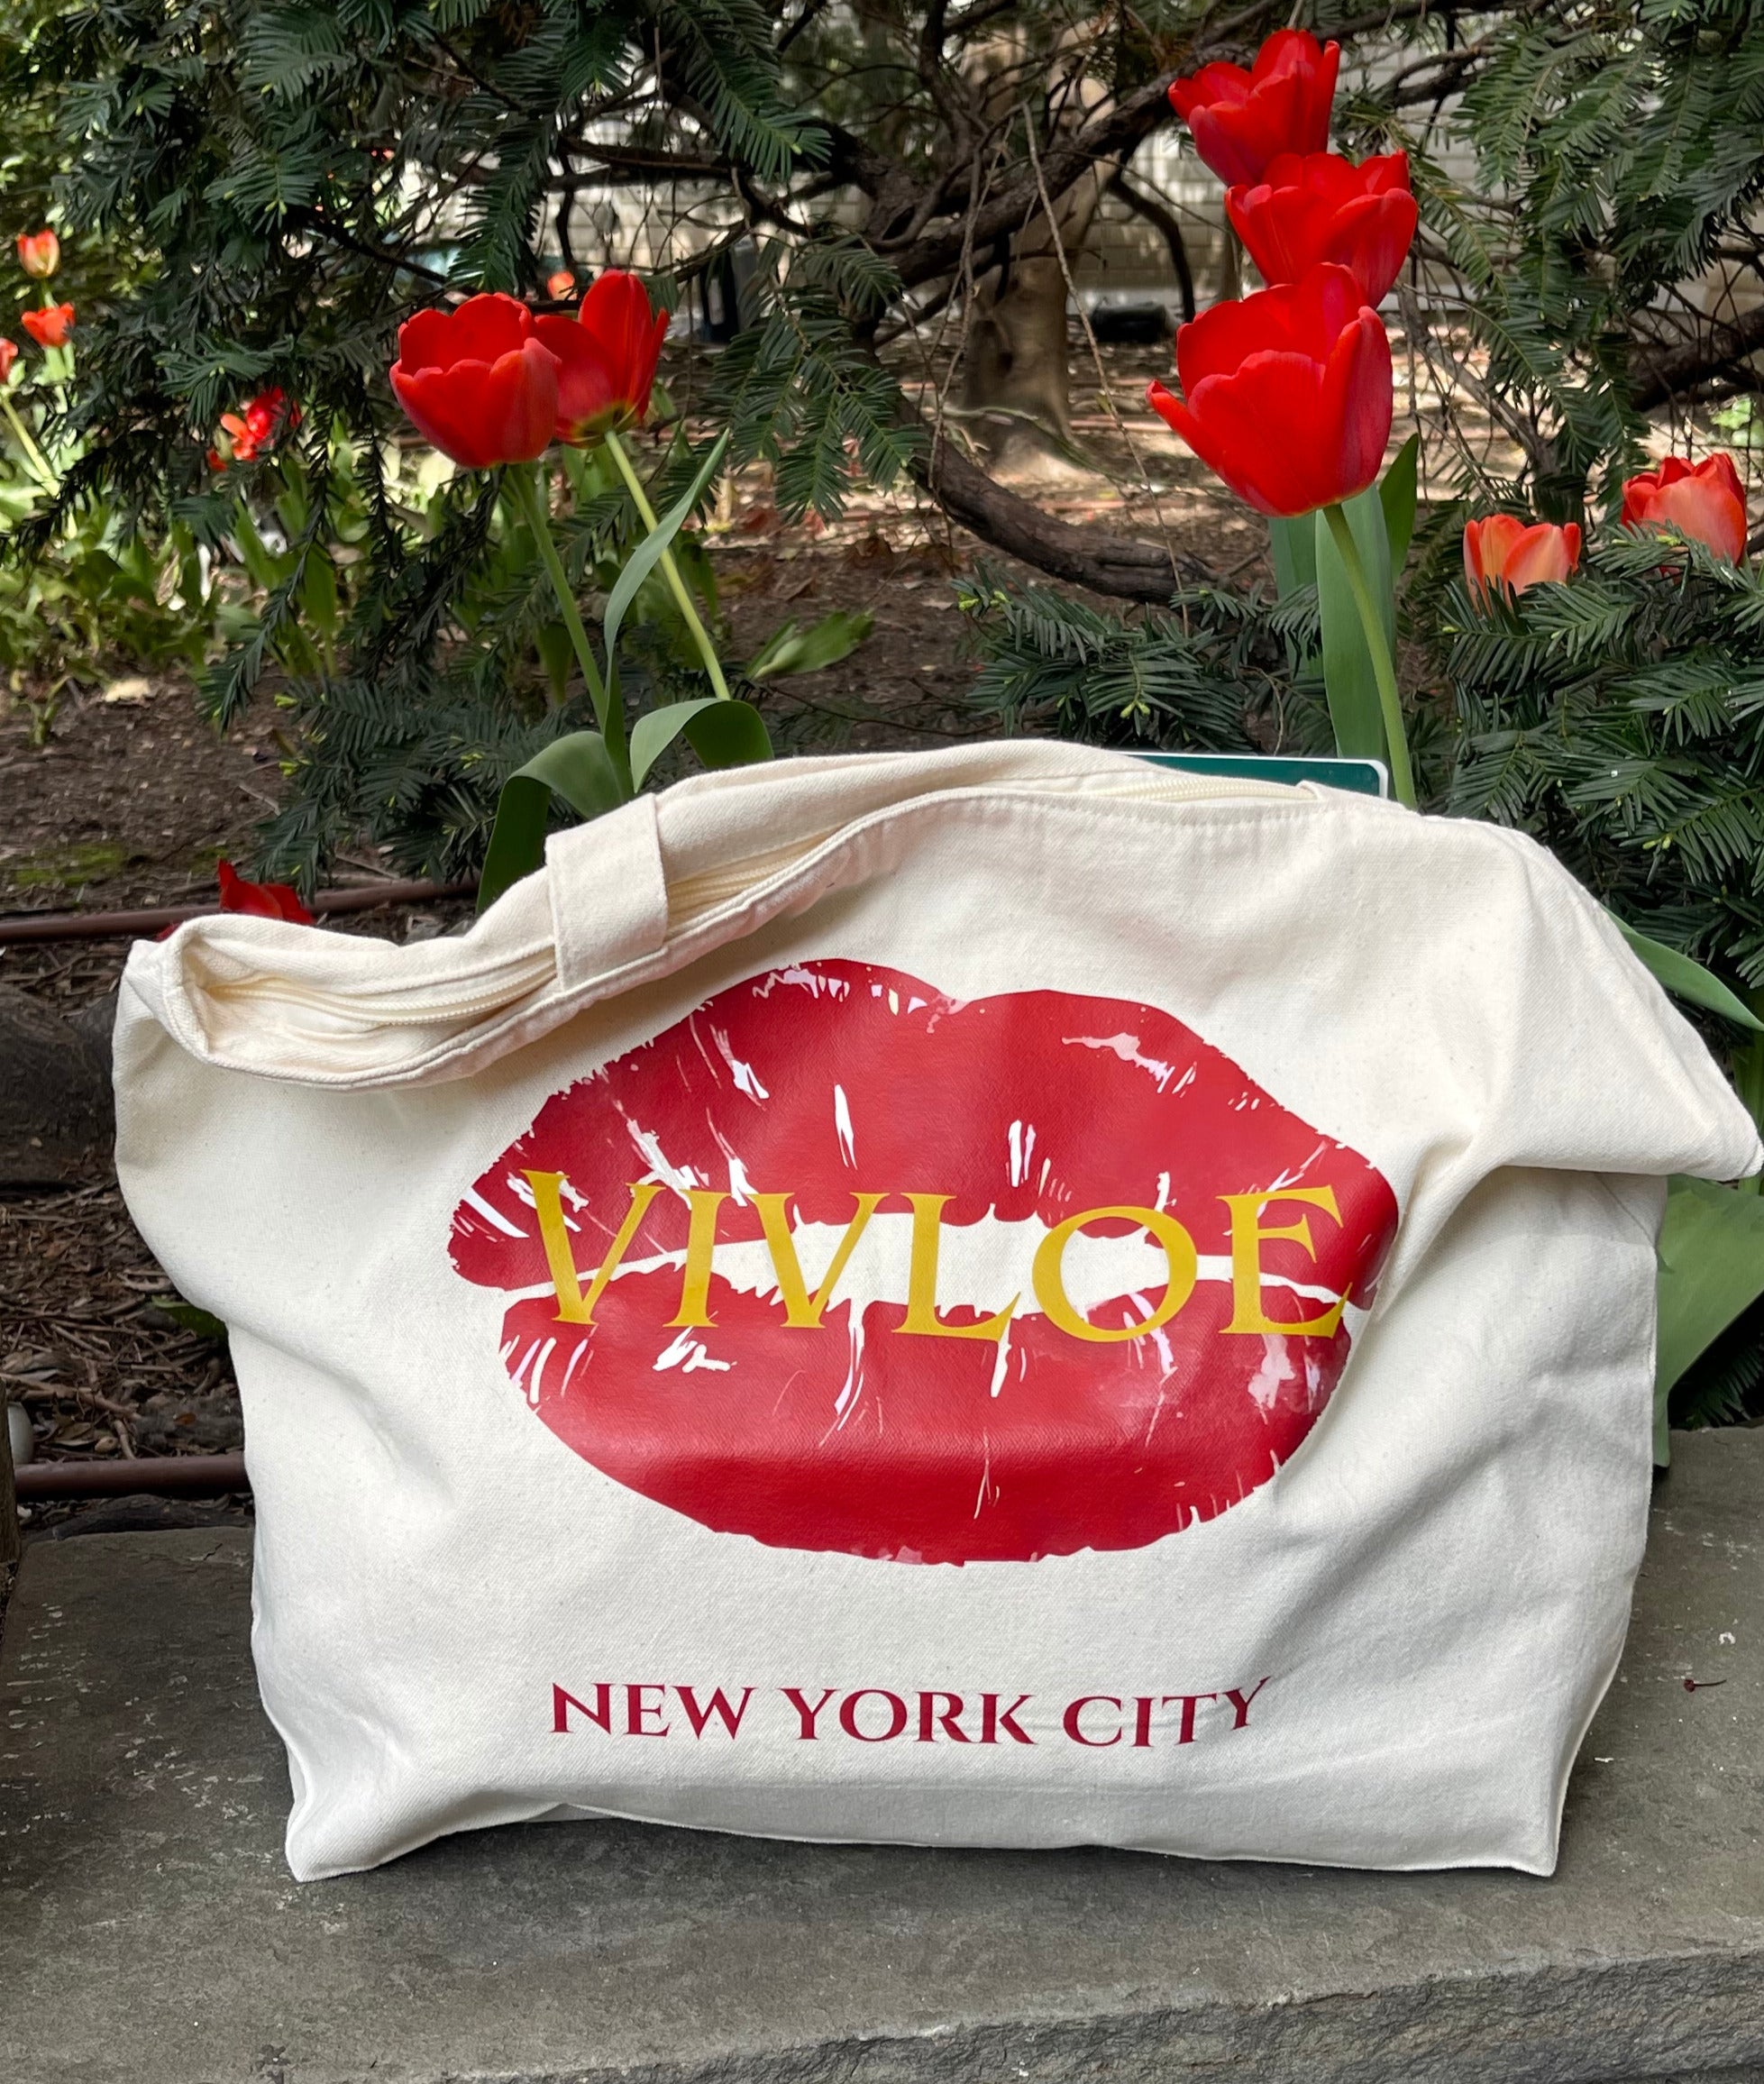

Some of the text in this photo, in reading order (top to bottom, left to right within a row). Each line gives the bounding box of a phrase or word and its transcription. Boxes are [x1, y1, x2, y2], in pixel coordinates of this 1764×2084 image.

[520, 1168, 1354, 1343] VIVLOE
[549, 1677, 1273, 1748] NEW YORK CITY
